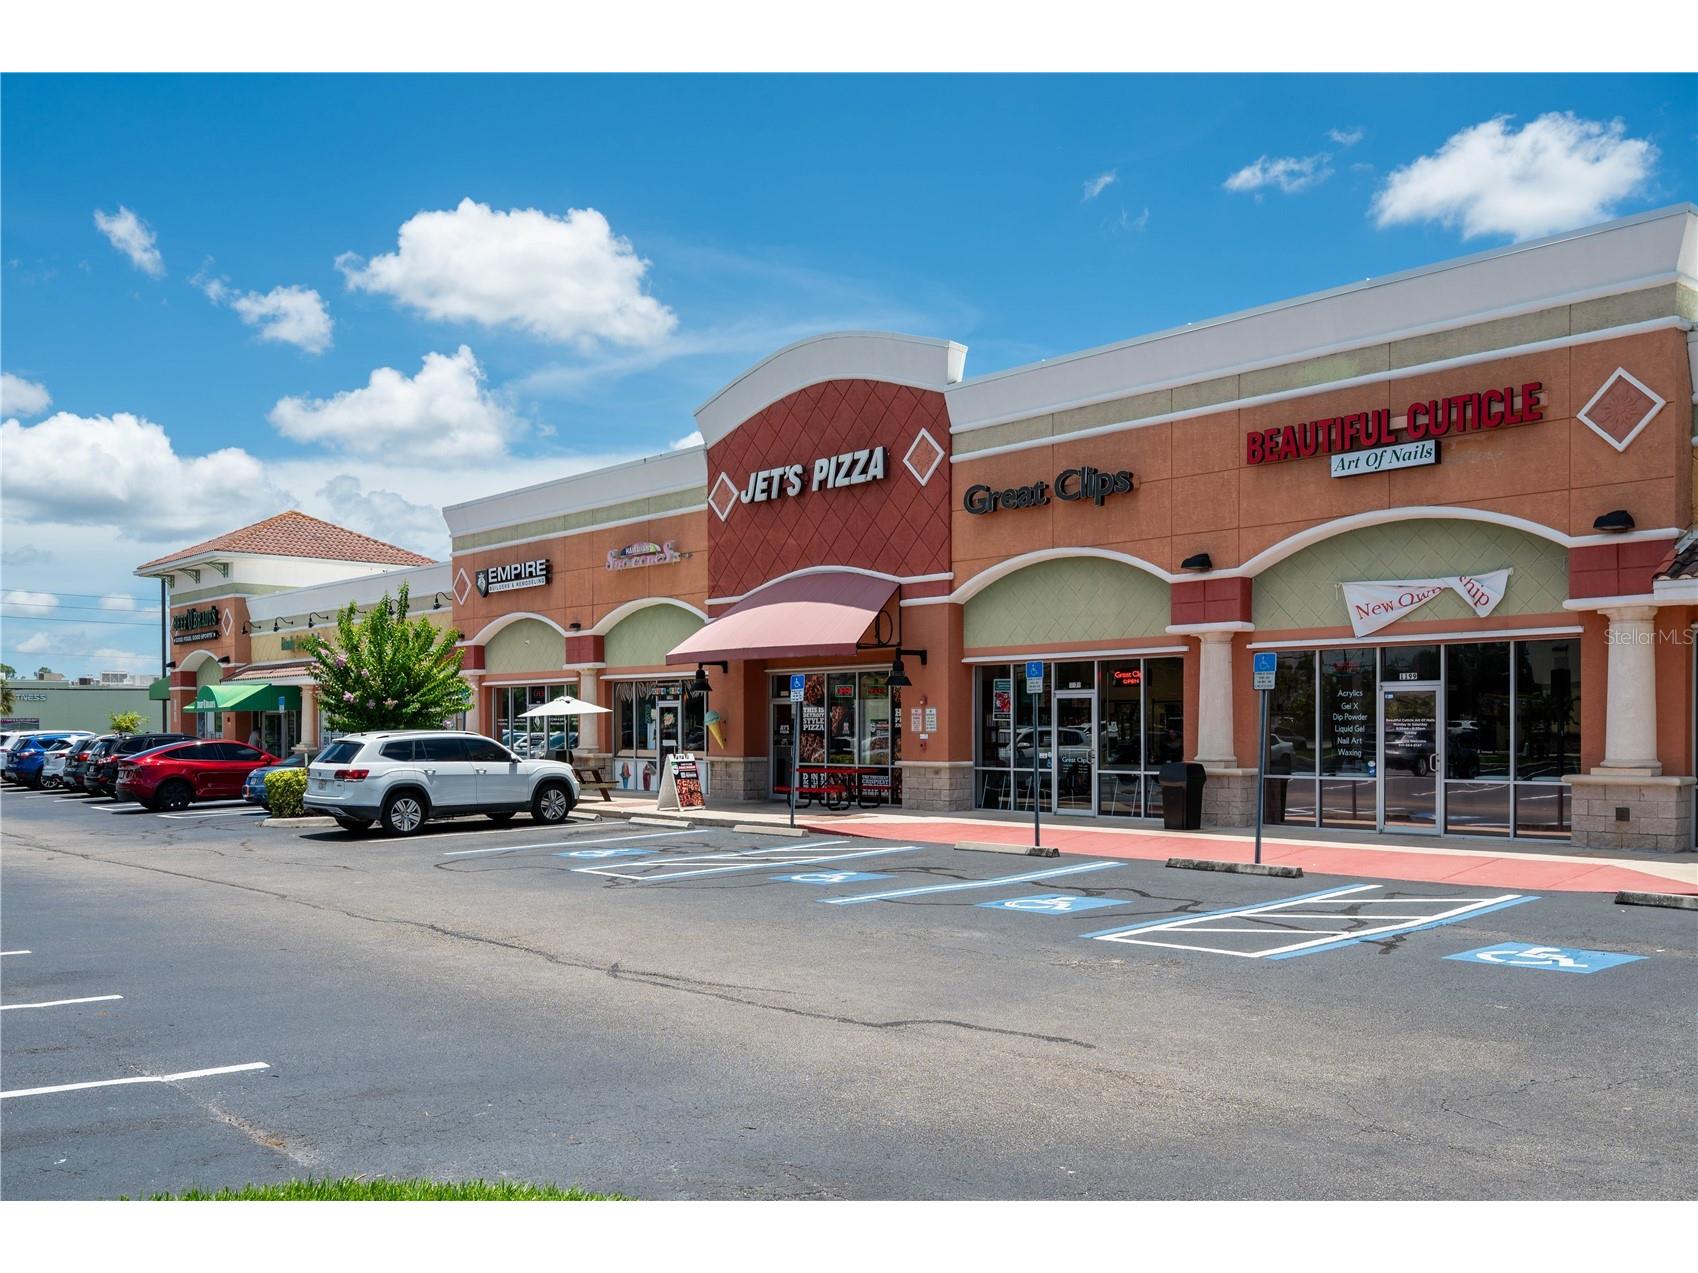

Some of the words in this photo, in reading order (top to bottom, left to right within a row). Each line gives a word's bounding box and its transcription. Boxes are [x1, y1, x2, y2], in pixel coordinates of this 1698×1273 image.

[1247, 408, 1398, 465] BEAUTIFUL
[1406, 382, 1543, 440] CUTICLE
[1333, 456, 1360, 473] Art
[1365, 450, 1387, 470] Of
[1388, 443, 1433, 465] Nails
[740, 464, 805, 504] JET'S
[811, 446, 885, 492] PIZZA
[963, 481, 1050, 515] Great
[1054, 465, 1134, 507] Clips
[488, 559, 547, 583] EMPIRE
[1355, 600, 1394, 620] New
[1337, 689, 1363, 699] Acrylics
[1340, 702, 1352, 710] Gel
[1353, 702, 1359, 710] X
[1332, 713, 1343, 722] Dip
[1344, 713, 1368, 721] Powder
[1334, 725, 1353, 733] Liquid
[1337, 748, 1362, 758] Waxing
